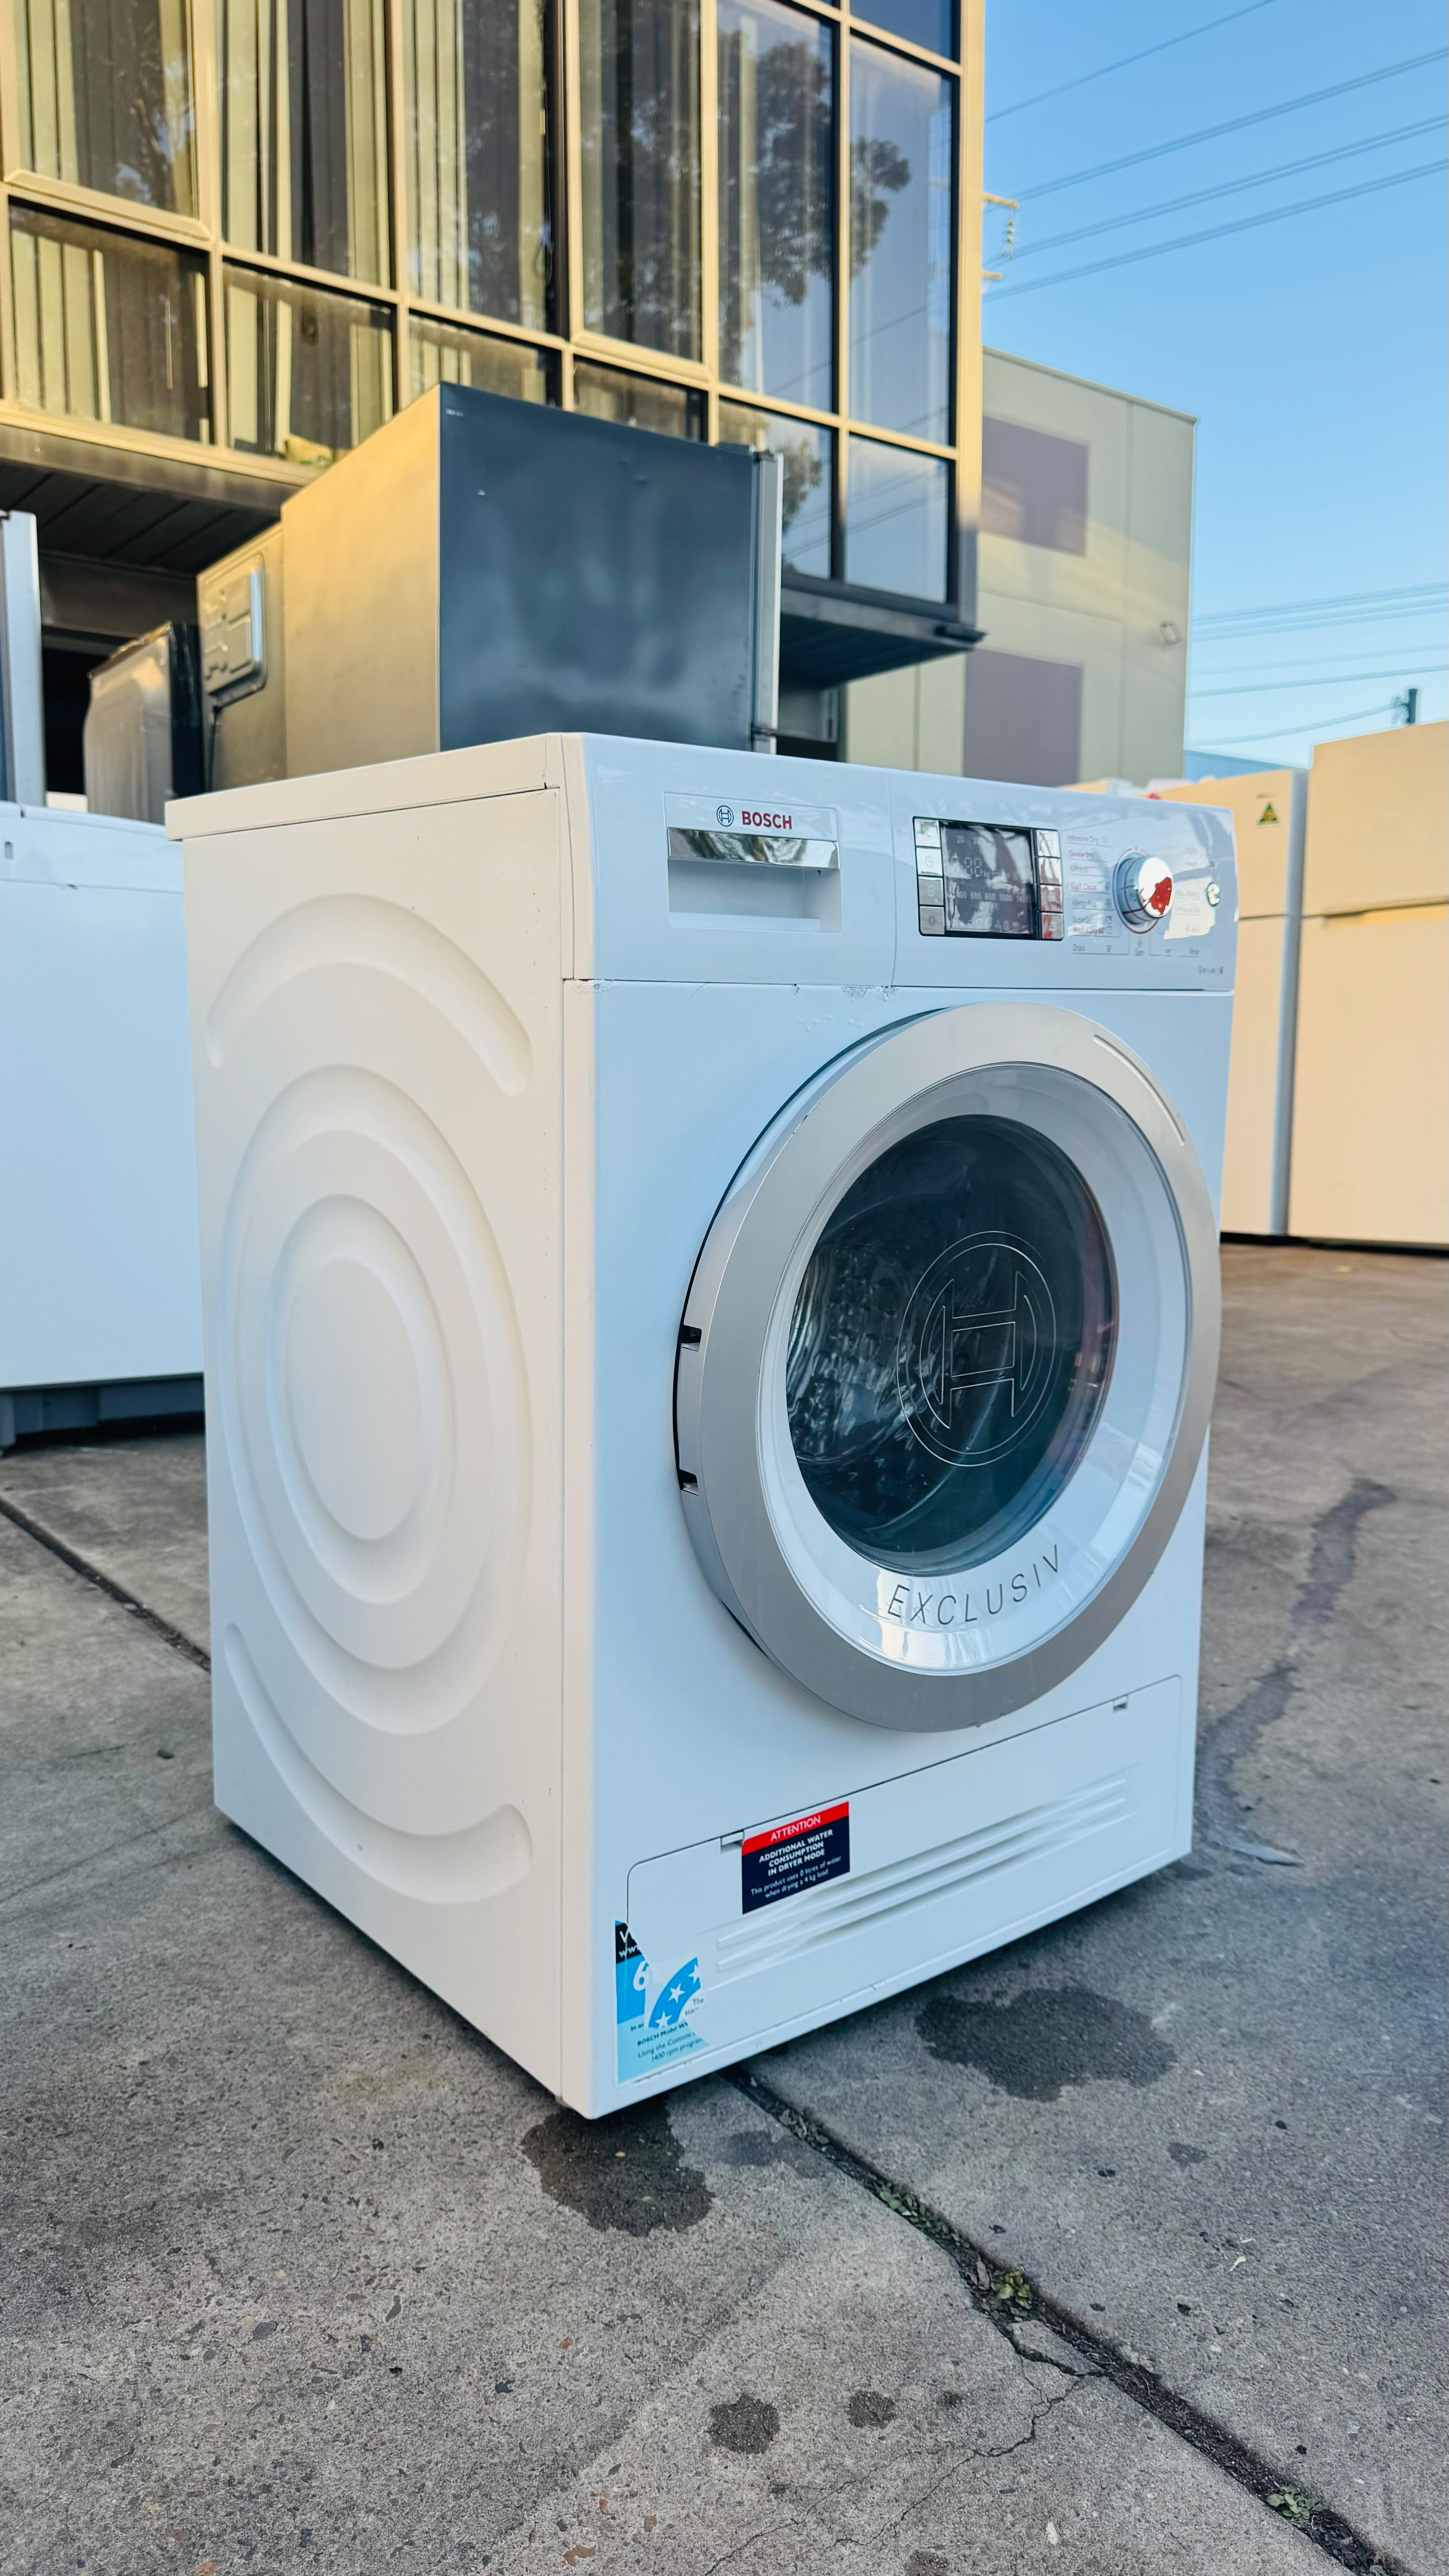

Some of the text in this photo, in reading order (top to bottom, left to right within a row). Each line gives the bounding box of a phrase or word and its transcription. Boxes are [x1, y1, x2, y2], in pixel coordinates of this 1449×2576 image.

[741, 811, 793, 830] BOSCH
[887, 1544, 1059, 1625] EXCLUSIV
[770, 1815, 821, 1841] ATTENTION
[759, 1829, 833, 1863] ADDITIONAL WATER
[769, 1841, 824, 1867] CONSUMPTION
[768, 1848, 825, 1876] IN DRYER MODE
[764, 1878, 785, 1892] product
[765, 1889, 780, 1898] when
[781, 1881, 799, 1893] drying
[809, 1874, 816, 1882] kg
[637, 2033, 659, 2046] BOSCH
[660, 2025, 677, 2037] Model
